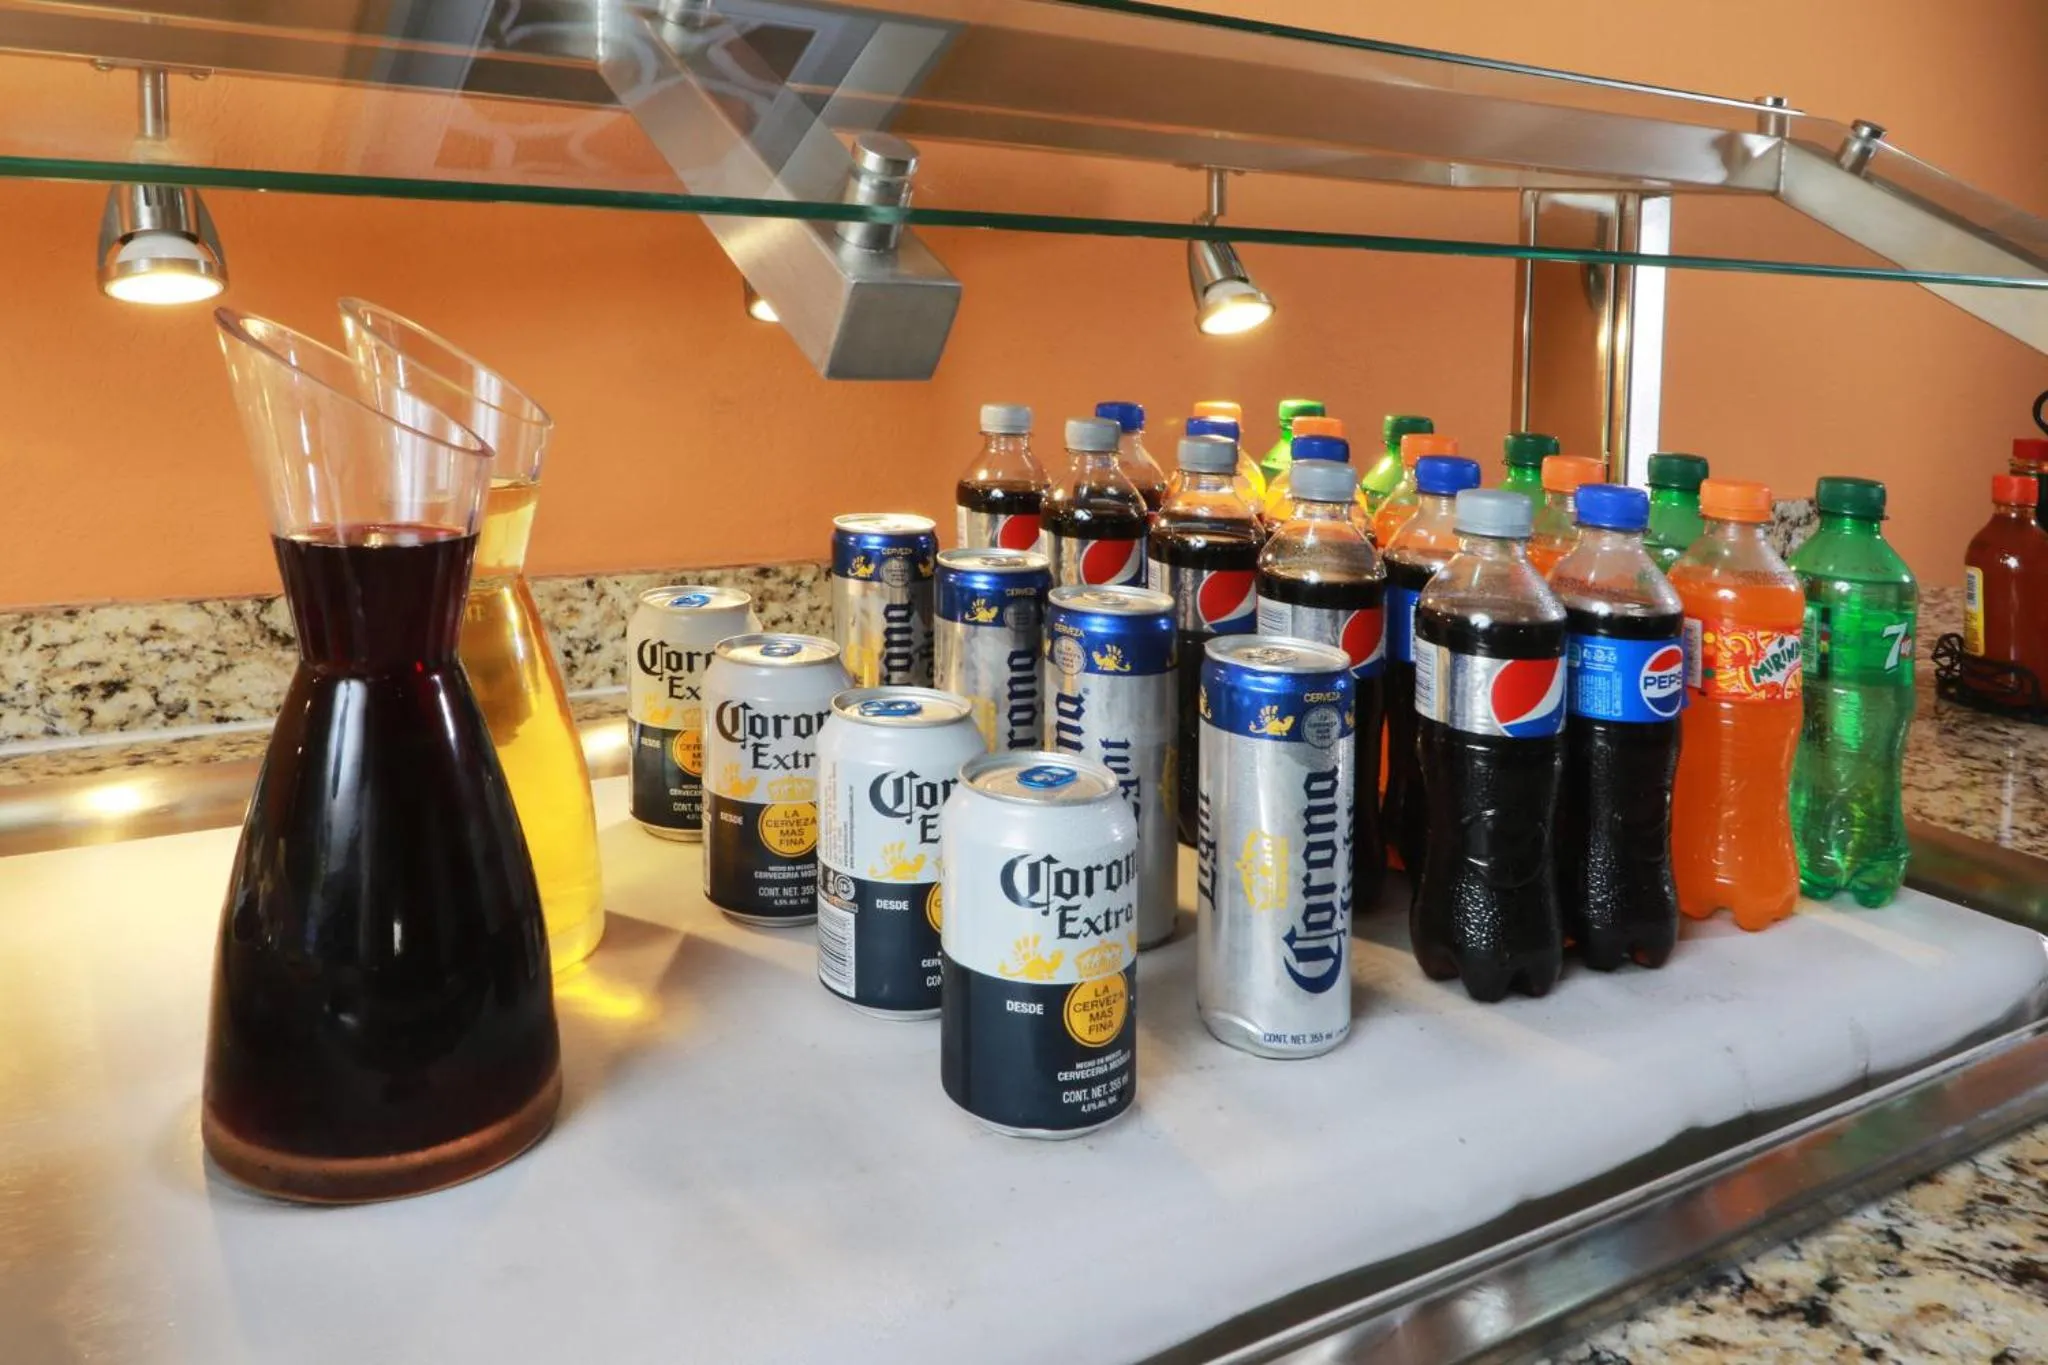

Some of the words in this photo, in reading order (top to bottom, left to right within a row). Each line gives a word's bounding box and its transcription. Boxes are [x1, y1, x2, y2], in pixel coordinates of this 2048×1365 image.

[637, 639, 716, 682] Cor
[1751, 641, 1800, 684] MIRIN
[1007, 651, 1038, 749] rona
[750, 742, 817, 771] Extr
[868, 770, 959, 825] Cor
[765, 816, 818, 828] CERVEZA
[784, 809, 800, 819] LA
[779, 838, 805, 847] FINA
[1000, 850, 1137, 916] Coron
[1282, 765, 1347, 994] Corona
[875, 898, 910, 911] DESDE
[1057, 903, 1134, 940] Extra
[1073, 990, 1124, 1013] CERVEZA
[1094, 984, 1109, 998] LA
[1006, 1000, 1044, 1015] DESDE
[1088, 1022, 1114, 1036] FINA
[1063, 1088, 1090, 1104] CONT.
[1091, 1084, 1108, 1099] NET.
